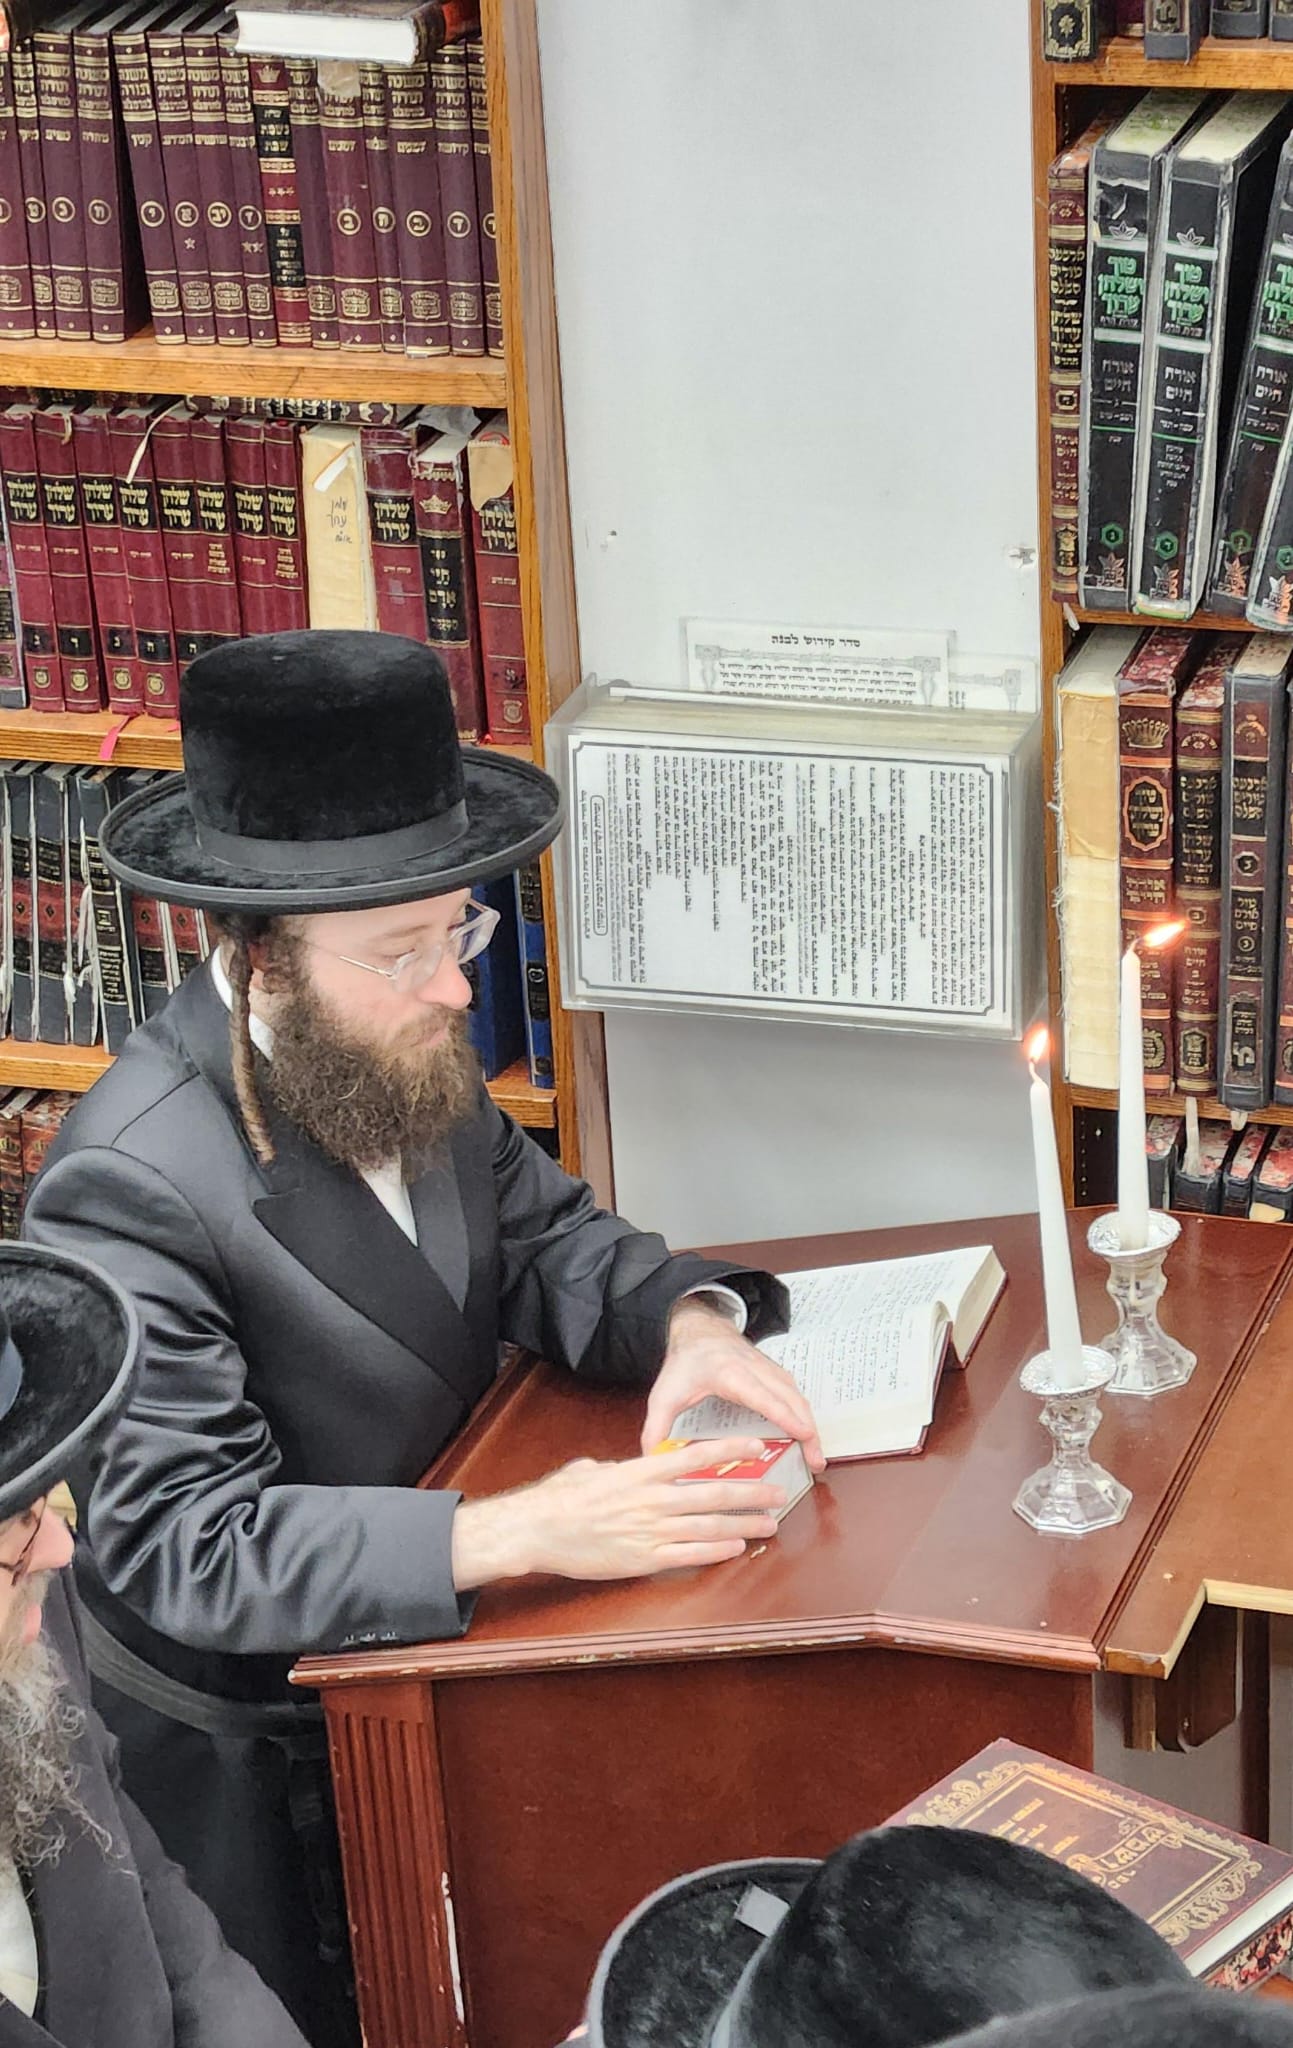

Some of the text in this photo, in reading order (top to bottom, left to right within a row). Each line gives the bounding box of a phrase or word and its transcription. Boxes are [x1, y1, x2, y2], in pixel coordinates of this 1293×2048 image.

[1098, 274, 1144, 296] ושלחן
[1164, 280, 1210, 305] ושלחן
[1102, 359, 1134, 375] אורח
[1164, 366, 1197, 384] אורח
[1104, 378, 1132, 393] חיים
[1165, 385, 1193, 402] חיים
[7, 479, 36, 500] שלחן
[44, 481, 75, 503] שלחן
[83, 480, 113, 502] שלחן
[119, 485, 149, 505] שלחן
[161, 486, 190, 507] שלחן
[197, 487, 224, 509] שלחן
[10, 501, 37, 520] ערוך
[235, 490, 263, 511] שלחן
[268, 491, 295, 513] שלחן
[374, 499, 410, 521] שלחן
[47, 503, 75, 522] ערוך
[86, 502, 114, 521] ערוך
[123, 507, 149, 526] ערוך
[164, 508, 191, 527] ערוך
[201, 511, 225, 530] ערוך
[479, 508, 515, 533] שלחן
[238, 512, 263, 532] ערוך
[271, 514, 295, 536] ערוך
[377, 522, 410, 541] ערוך
[482, 530, 516, 550] ערוך
[771, 633, 861, 648] סדר קידוש לבנה
[1107, 1869, 1137, 1890] ספר
